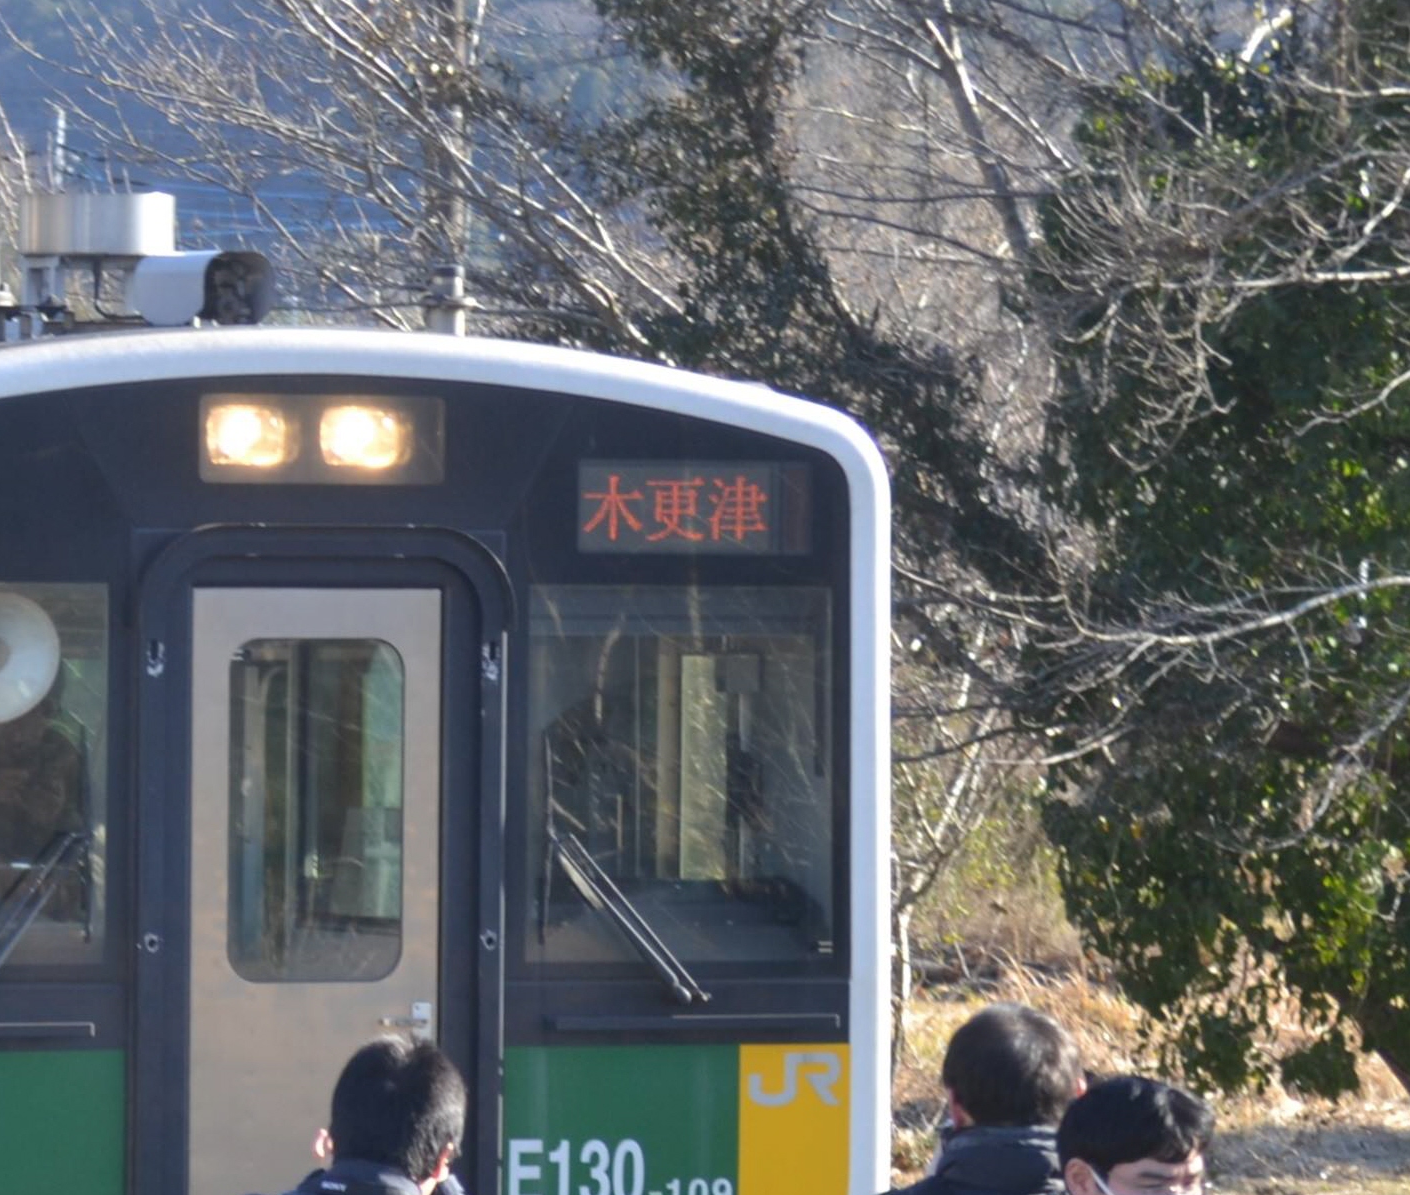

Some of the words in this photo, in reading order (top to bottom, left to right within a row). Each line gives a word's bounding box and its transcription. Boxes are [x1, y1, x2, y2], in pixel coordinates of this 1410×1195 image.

[583, 475, 768, 541] 木更津
[748, 1052, 841, 1106] JR
